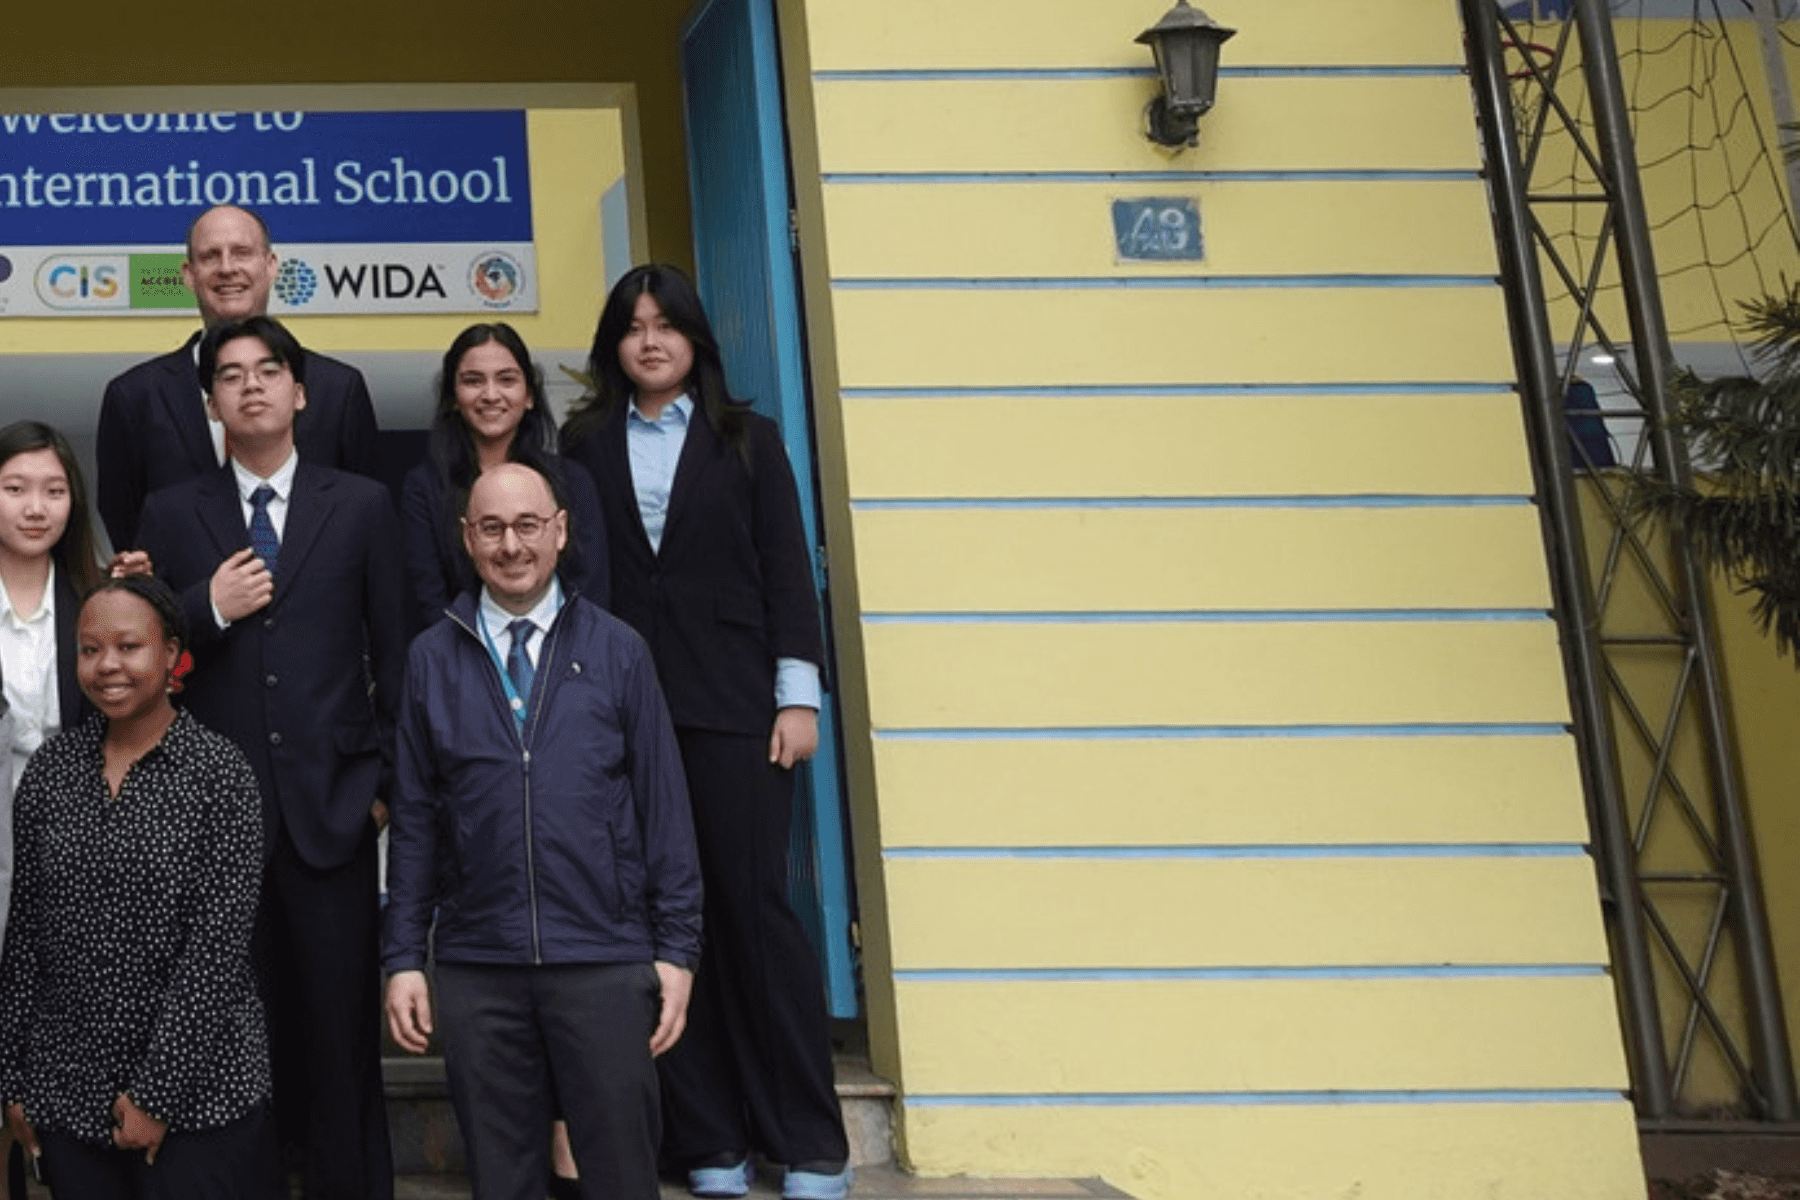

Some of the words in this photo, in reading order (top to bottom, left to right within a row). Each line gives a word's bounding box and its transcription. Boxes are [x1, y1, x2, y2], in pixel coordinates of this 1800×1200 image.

[334, 155, 513, 204] School
[49, 264, 119, 298] CIS
[323, 264, 447, 299] WIDA
